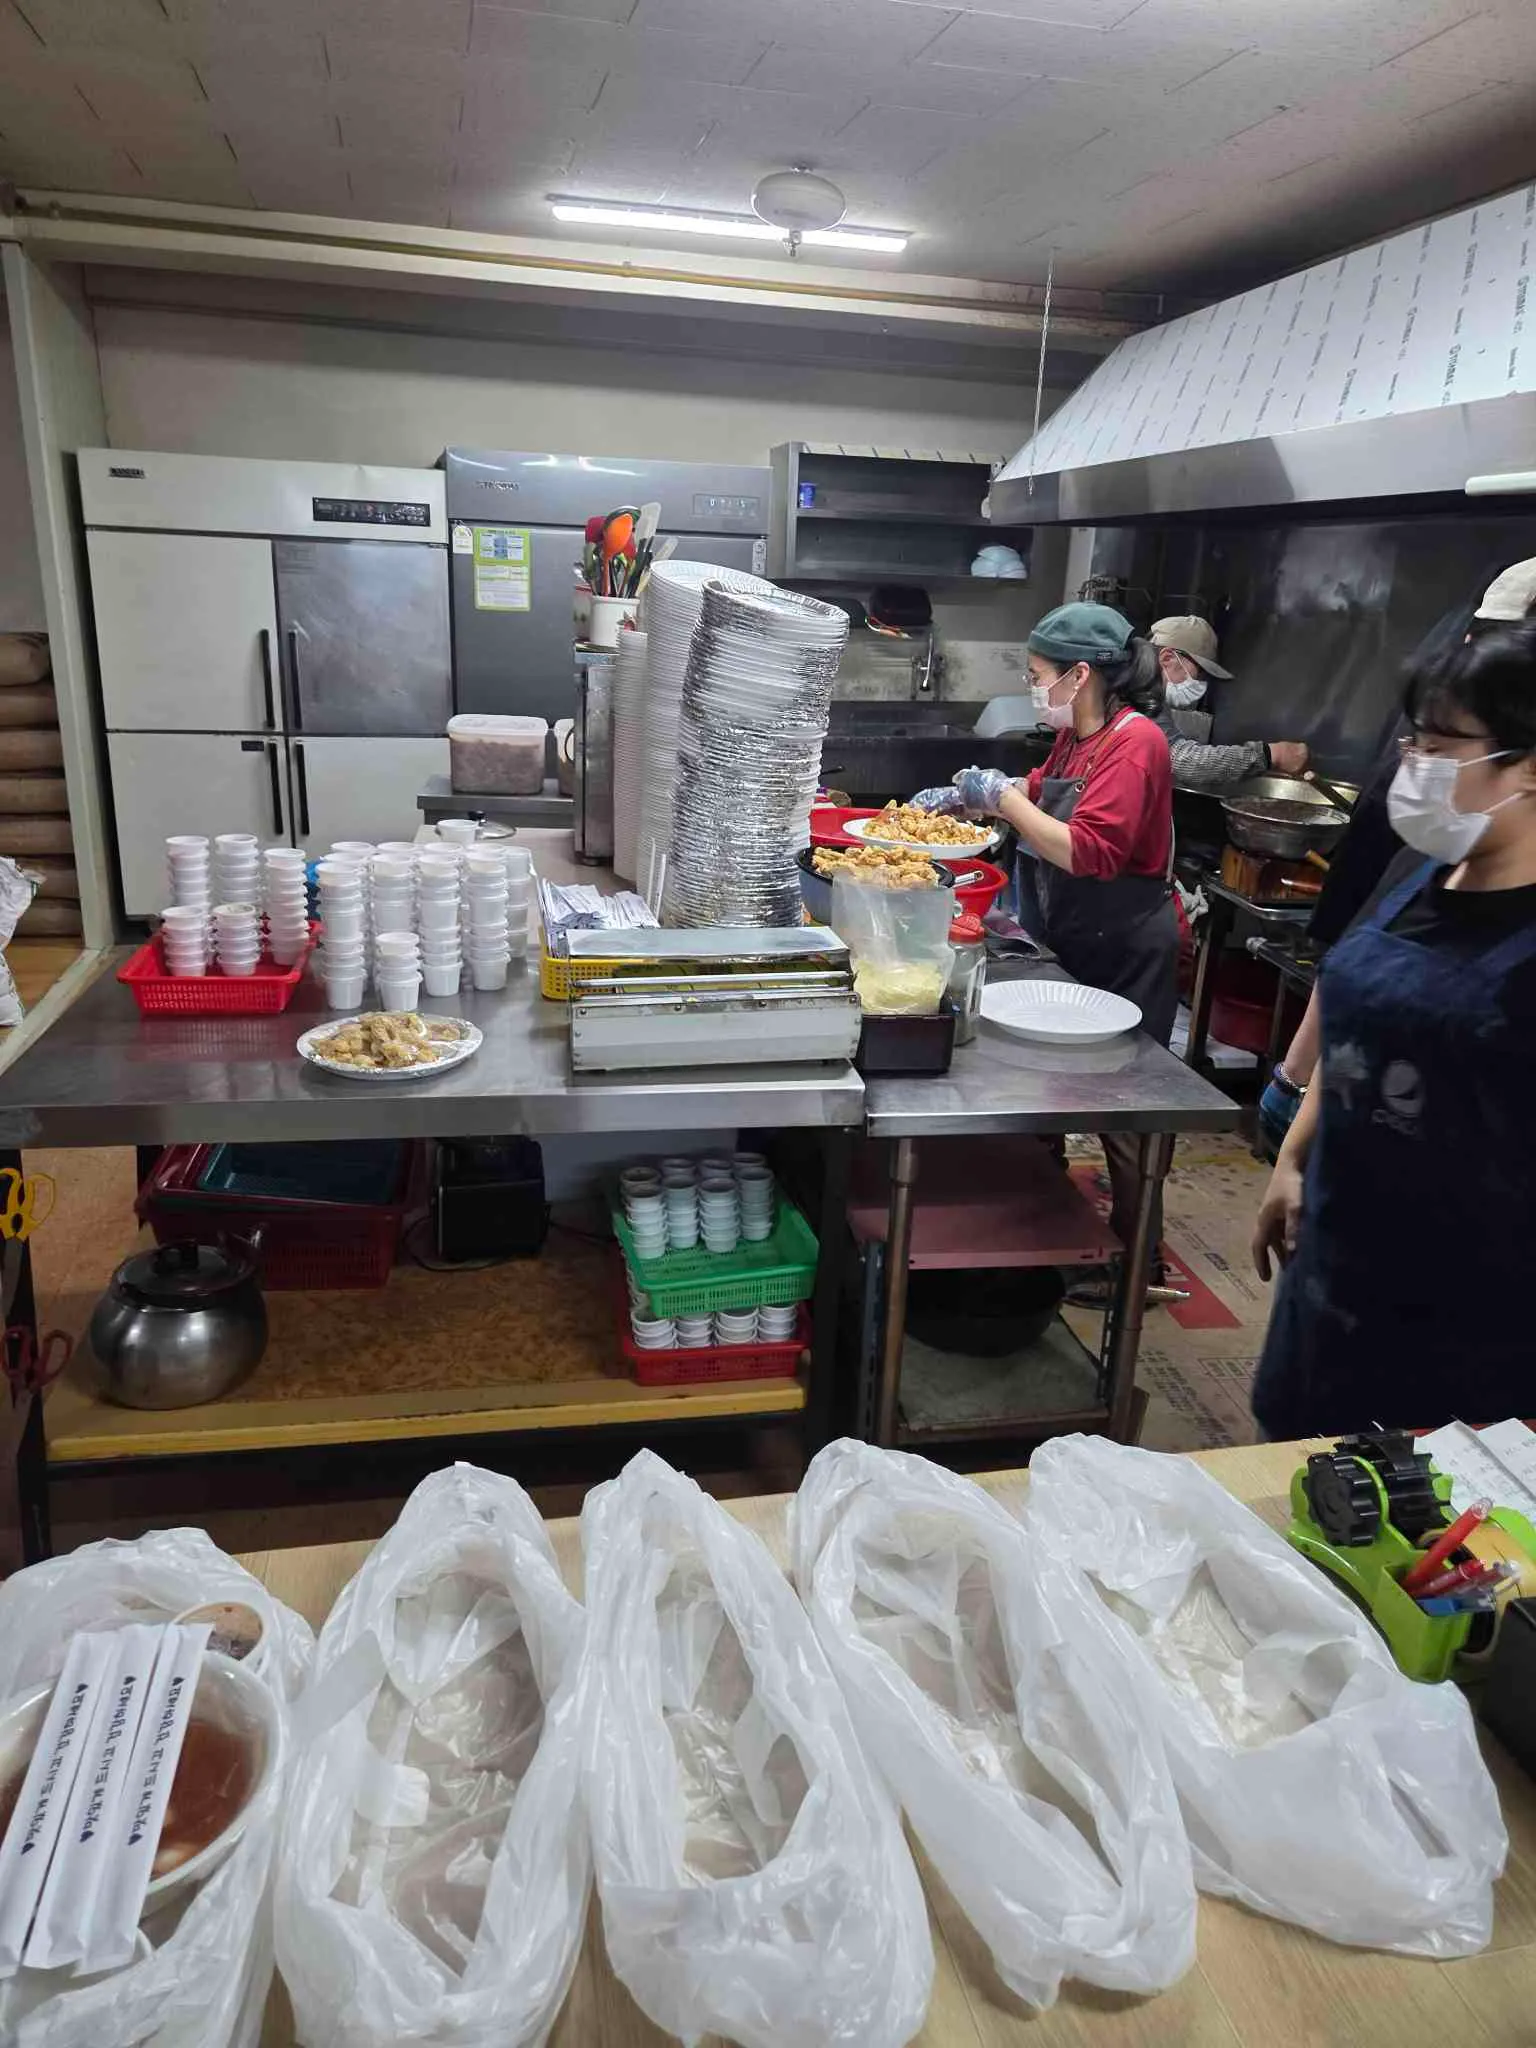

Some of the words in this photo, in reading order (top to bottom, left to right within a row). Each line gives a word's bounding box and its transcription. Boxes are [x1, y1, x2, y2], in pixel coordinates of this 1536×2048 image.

[25, 1797, 51, 1843] 맛있게
[41, 1755, 64, 1796] 드시고
[83, 1788, 105, 1832] 맛있게
[95, 1746, 116, 1785] 드시고
[131, 1791, 153, 1834] 맛있게
[143, 1747, 164, 1788] 드시고
